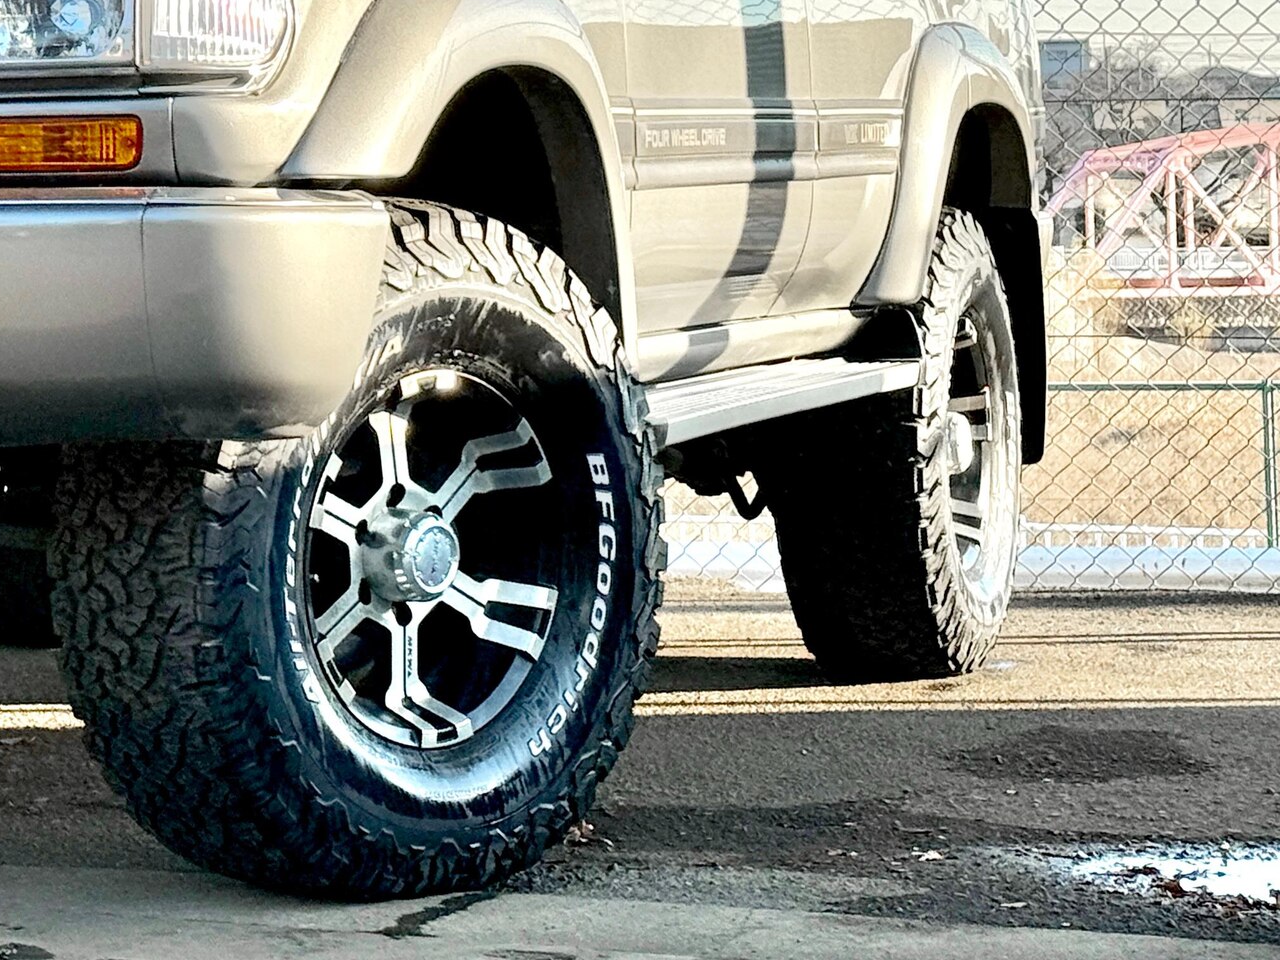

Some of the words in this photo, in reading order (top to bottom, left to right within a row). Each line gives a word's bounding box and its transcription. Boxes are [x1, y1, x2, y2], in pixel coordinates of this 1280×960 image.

[645, 129, 670, 148] FOUR
[671, 128, 701, 147] WHEEL
[701, 127, 726, 146] DRIVE
[528, 452, 618, 758] BFGoodrich
